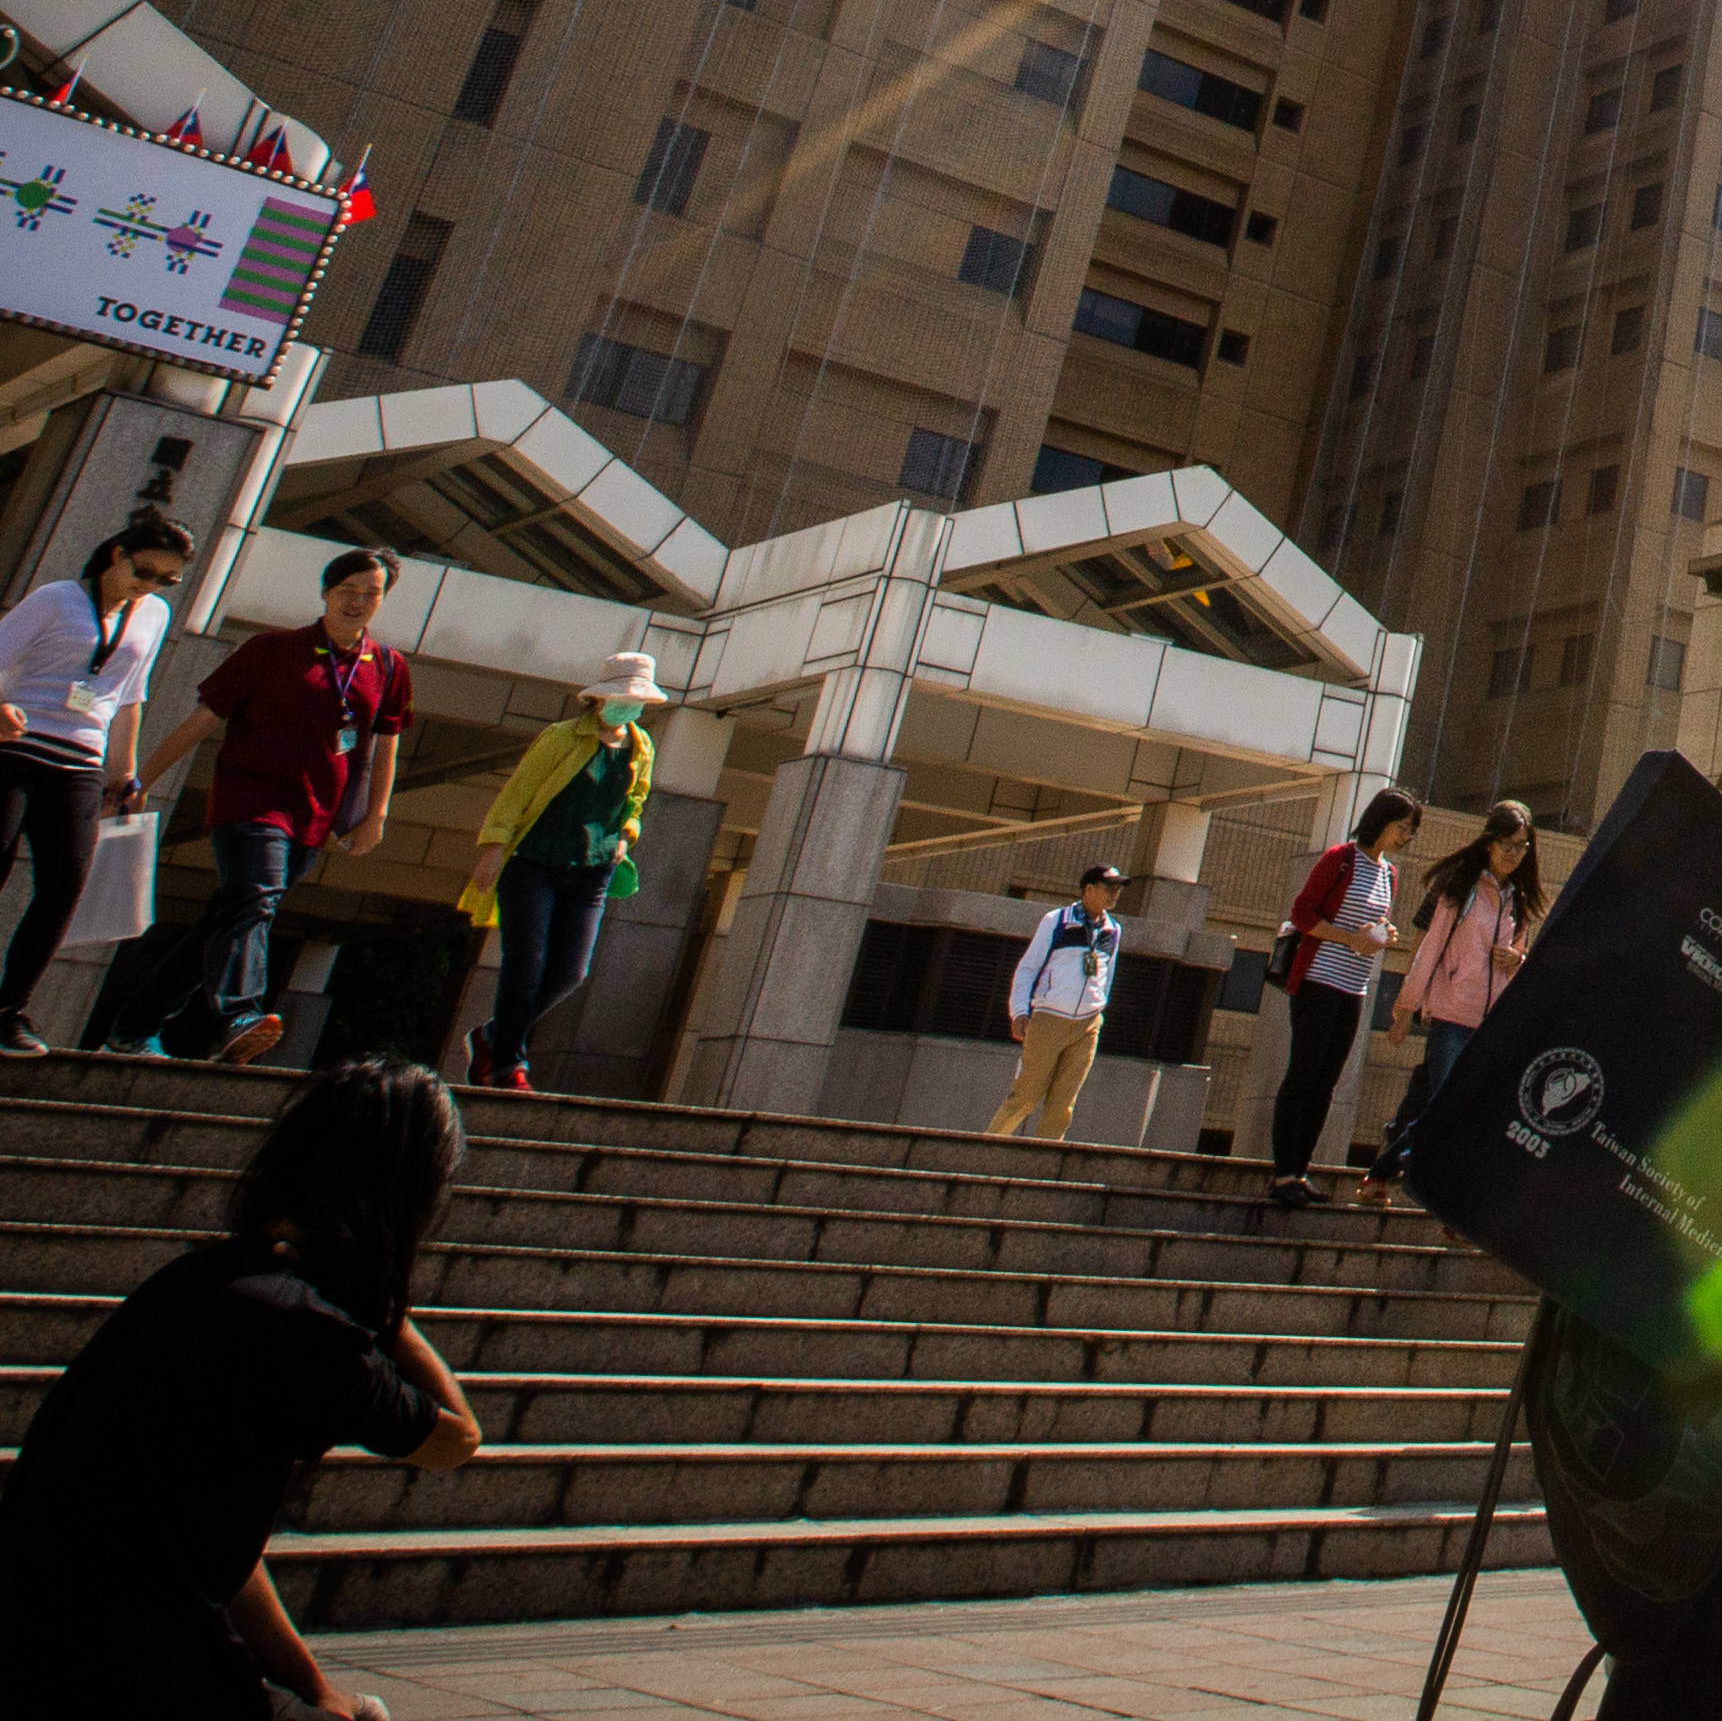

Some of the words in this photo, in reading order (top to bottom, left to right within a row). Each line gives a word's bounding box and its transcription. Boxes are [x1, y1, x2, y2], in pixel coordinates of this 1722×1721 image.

[97, 295, 268, 359] TOGETHER
[1505, 1120, 1551, 1160] 2003
[1590, 1121, 1638, 1167] Taiwan
[1636, 1155, 1688, 1203] Society
[1686, 1195, 1708, 1212] of
[1618, 1174, 1680, 1224] Internal
